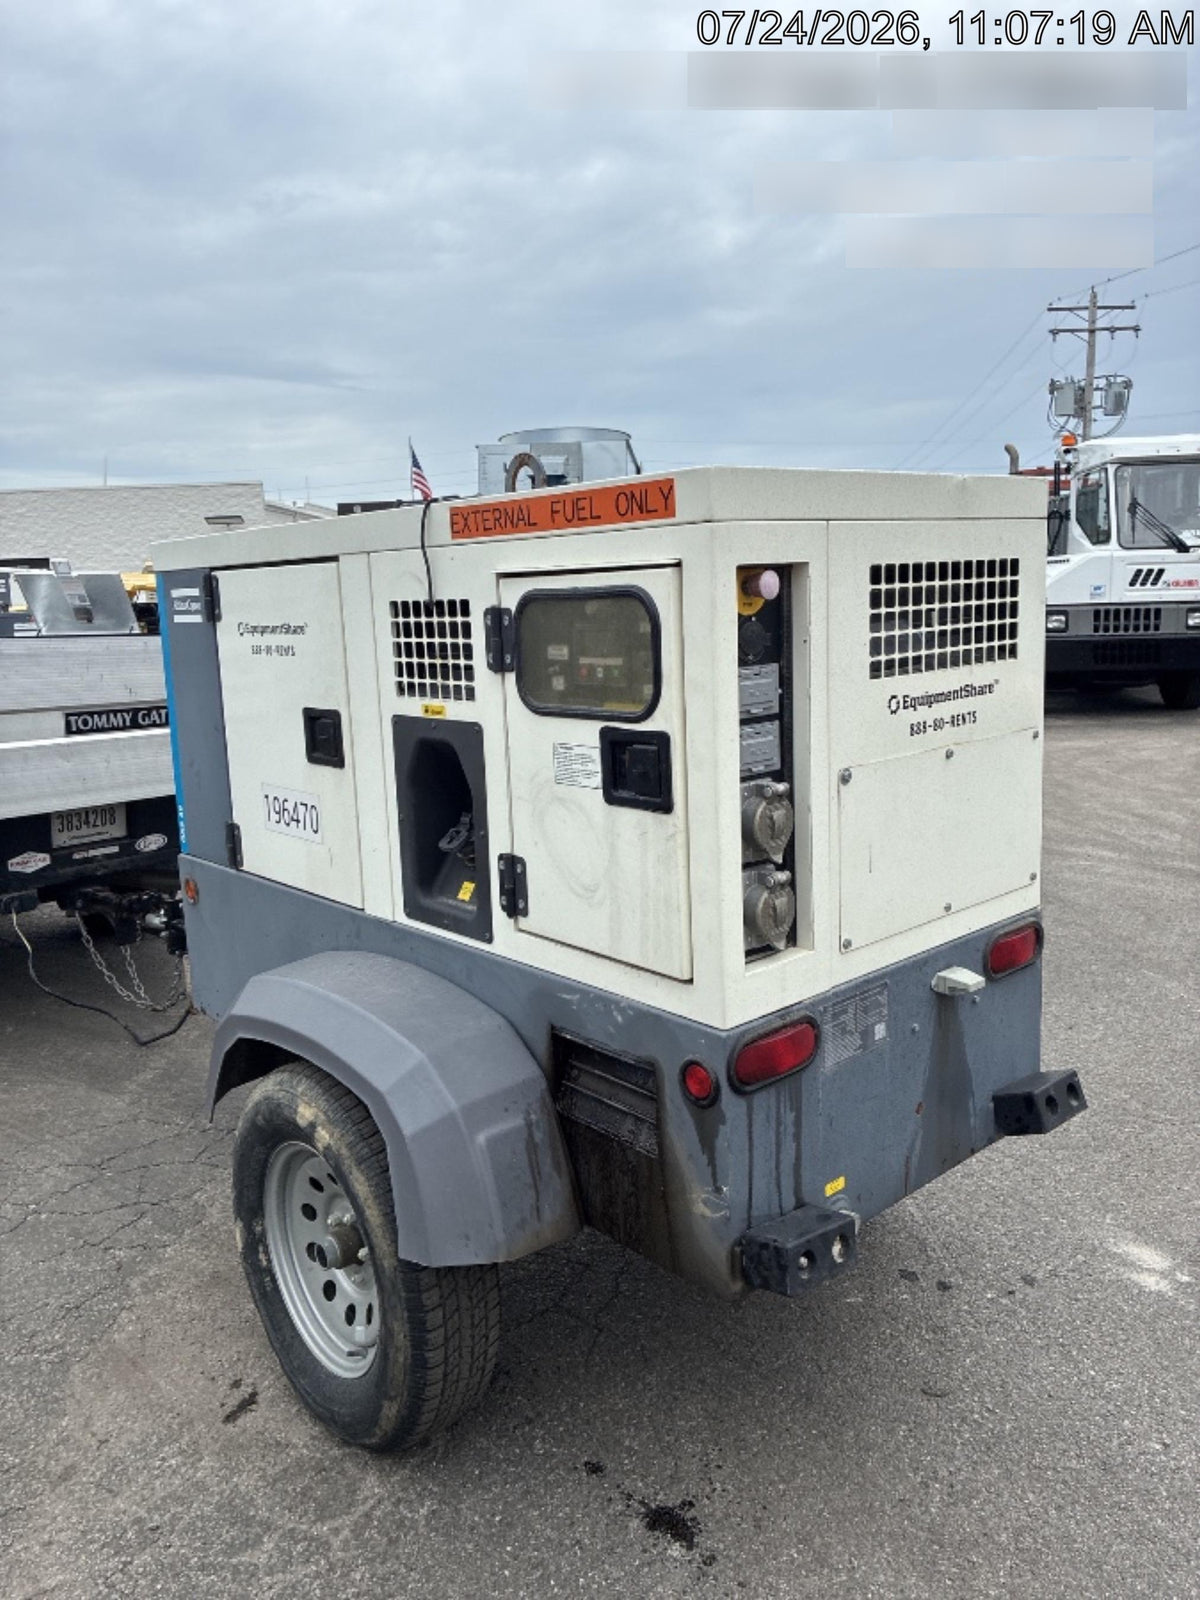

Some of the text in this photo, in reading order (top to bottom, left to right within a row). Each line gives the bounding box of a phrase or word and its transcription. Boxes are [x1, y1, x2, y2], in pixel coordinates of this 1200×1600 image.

[451, 485, 674, 534] EXTERNAL FUEL ONLY
[902, 683, 995, 711] EquipmentShare
[68, 711, 132, 731] TOMMY
[909, 711, 977, 736] 888-80-RENTS
[57, 806, 117, 833] 3834208
[264, 794, 319, 834] 196470
